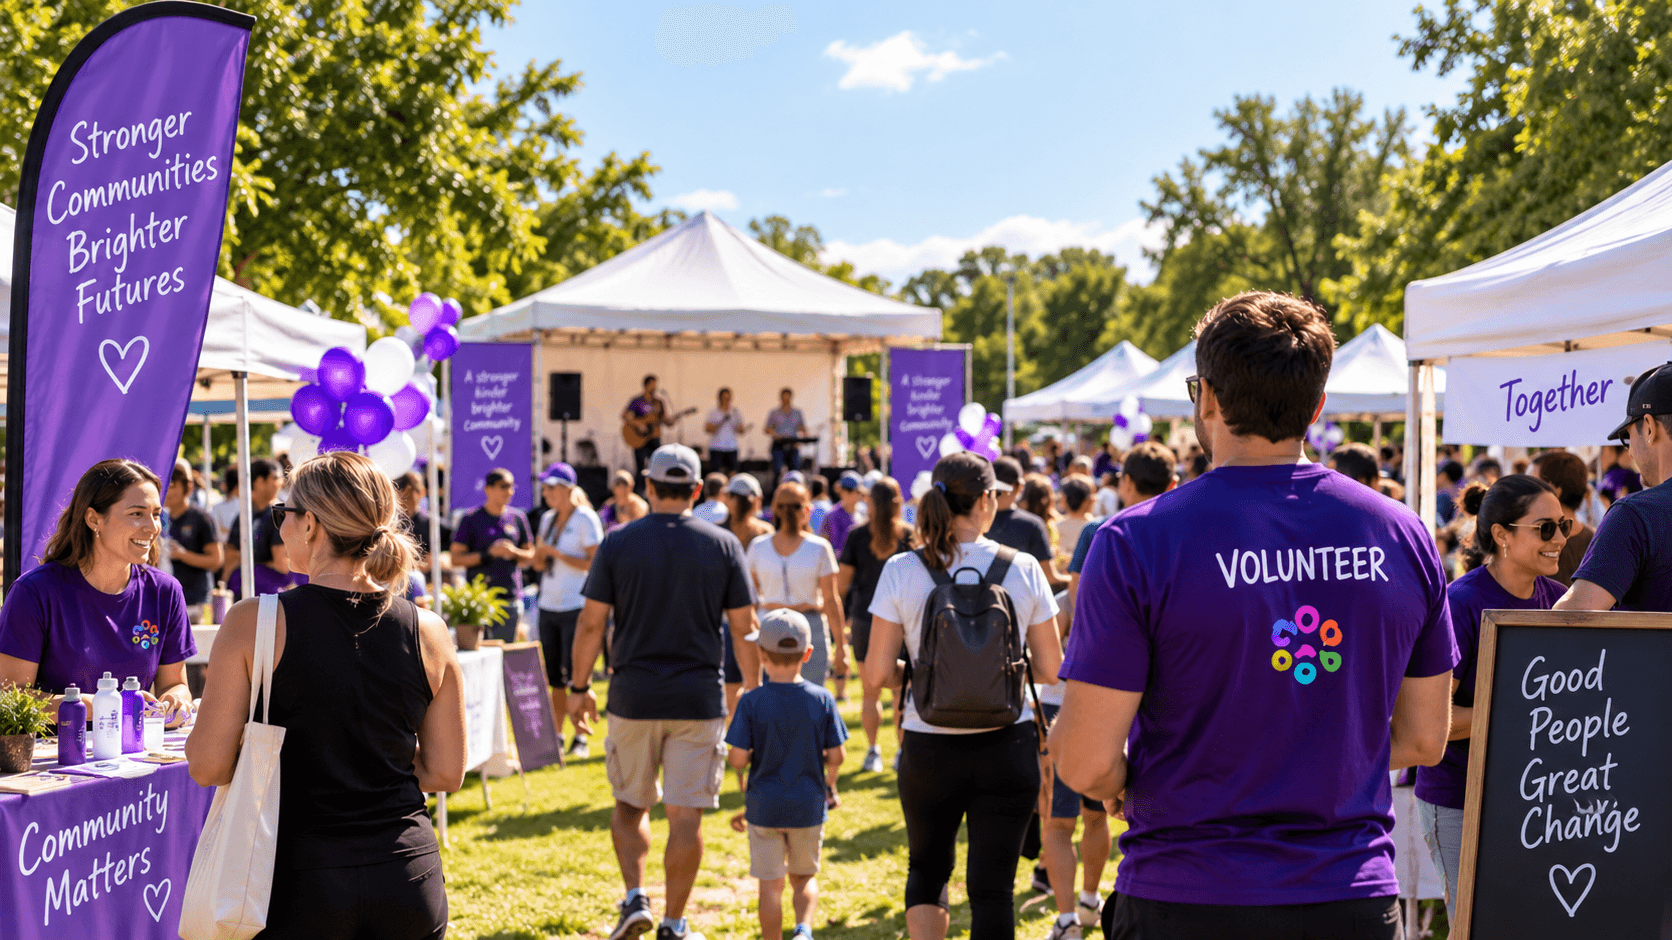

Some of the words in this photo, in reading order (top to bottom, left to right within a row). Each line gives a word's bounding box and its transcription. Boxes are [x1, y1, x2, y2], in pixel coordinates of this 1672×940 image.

[70, 111, 192, 165] Stronger
[47, 153, 218, 225] Communities
[66, 211, 188, 273] Brighter
[76, 266, 185, 324] Futures
[464, 369, 473, 384] A
[476, 370, 519, 387] stronger
[1499, 369, 1613, 432] Together
[1215, 546, 1389, 589] VOLUNTEER
[1521, 648, 1606, 701] Good
[1529, 697, 1630, 757] People
[1519, 752, 1618, 803] Great
[18, 783, 169, 876] Community
[1520, 803, 1641, 853] Change
[44, 847, 151, 926] Matters
